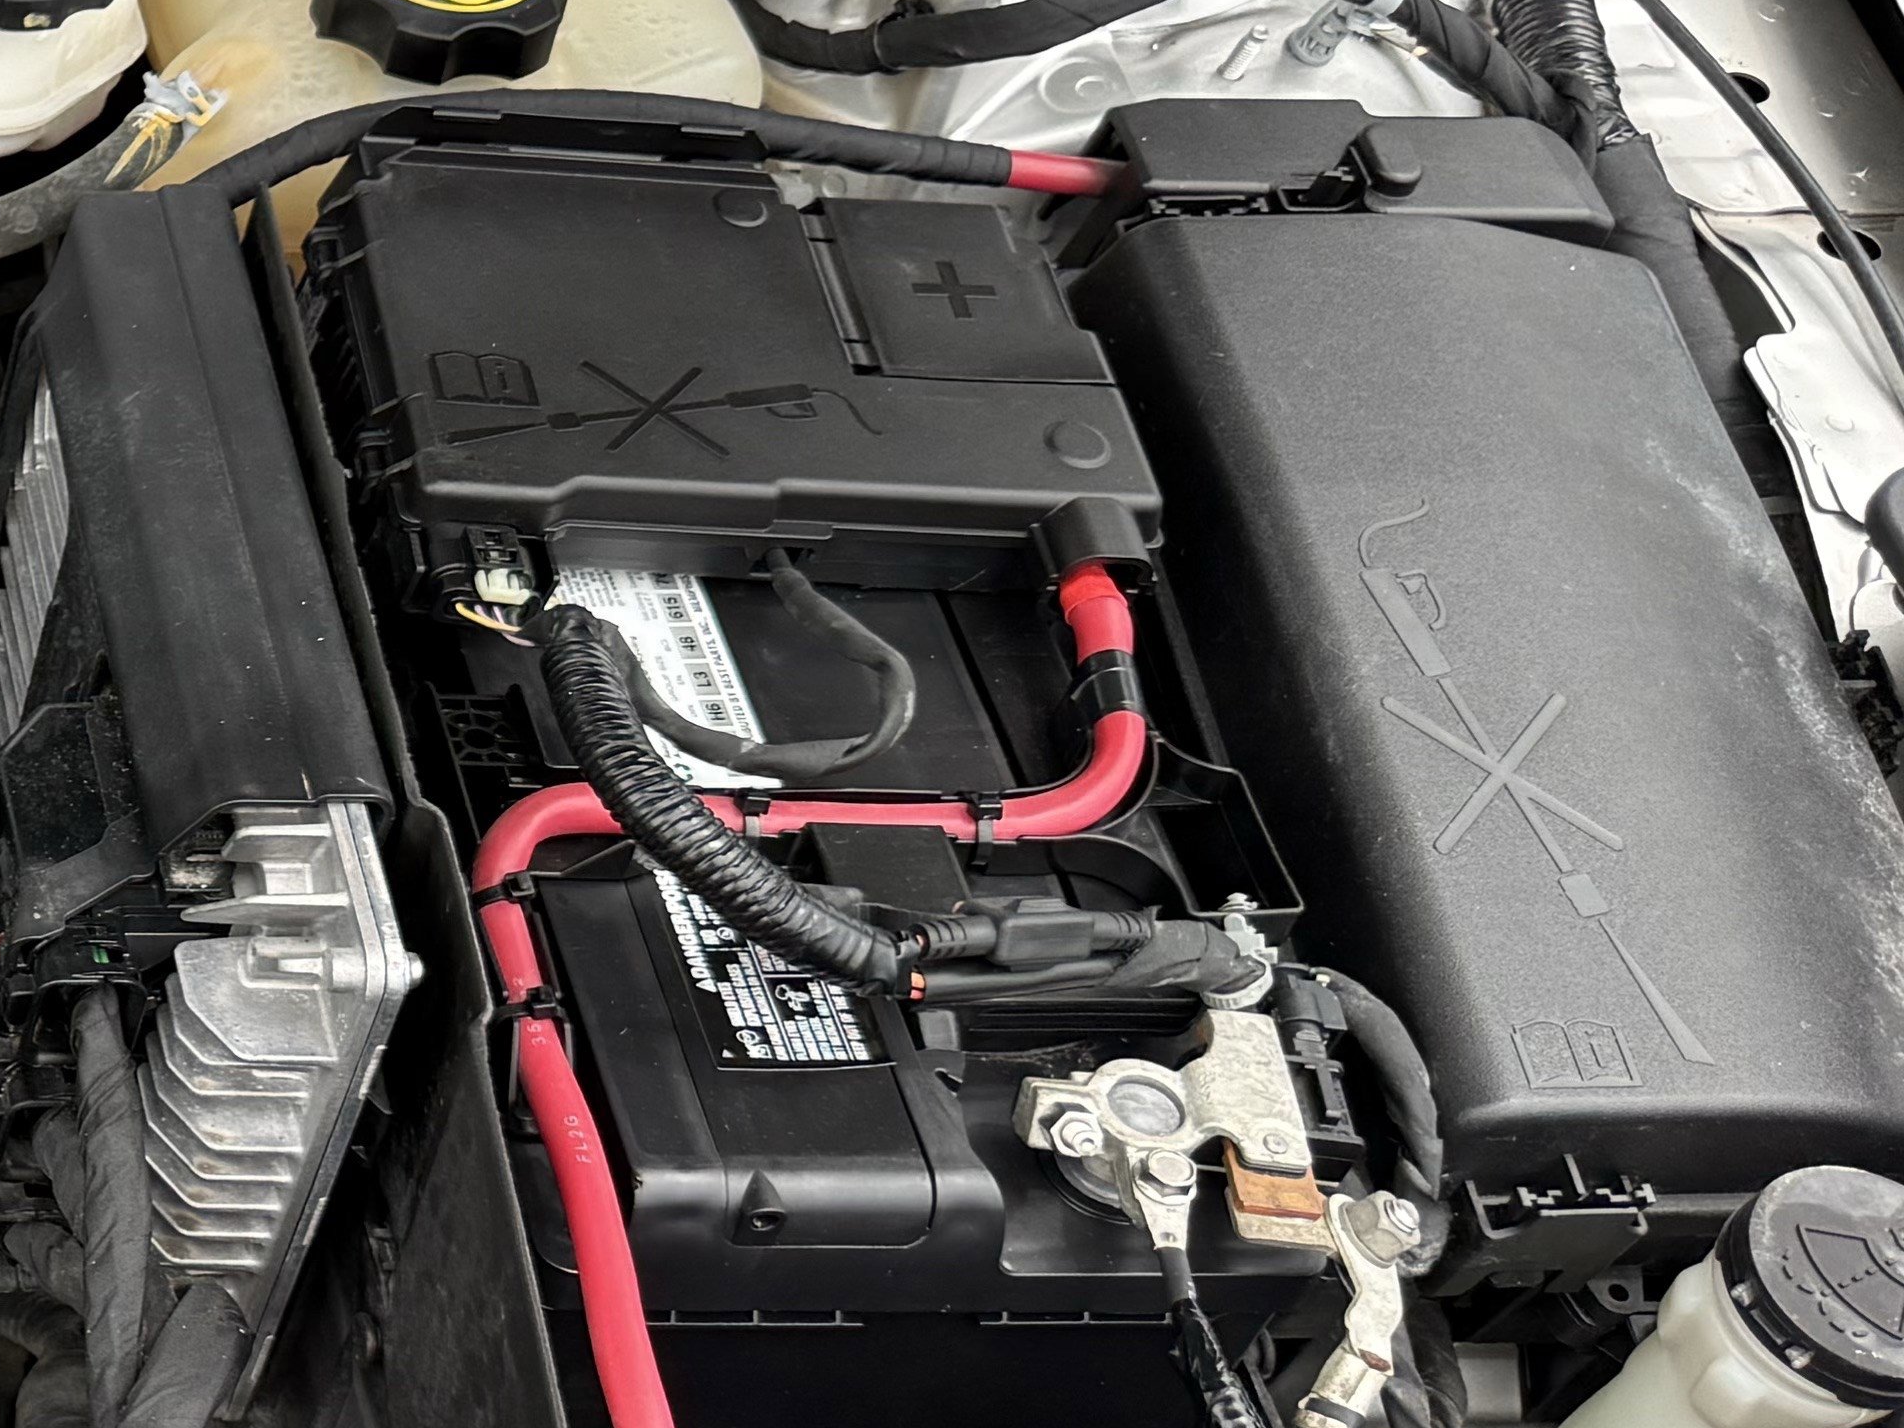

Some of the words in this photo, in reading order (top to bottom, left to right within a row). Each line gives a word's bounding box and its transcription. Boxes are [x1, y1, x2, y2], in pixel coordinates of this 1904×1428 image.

[663, 597, 684, 620] 615
[679, 636, 697, 651] 48
[693, 671, 712, 688] L3
[705, 703, 724, 721] H6
